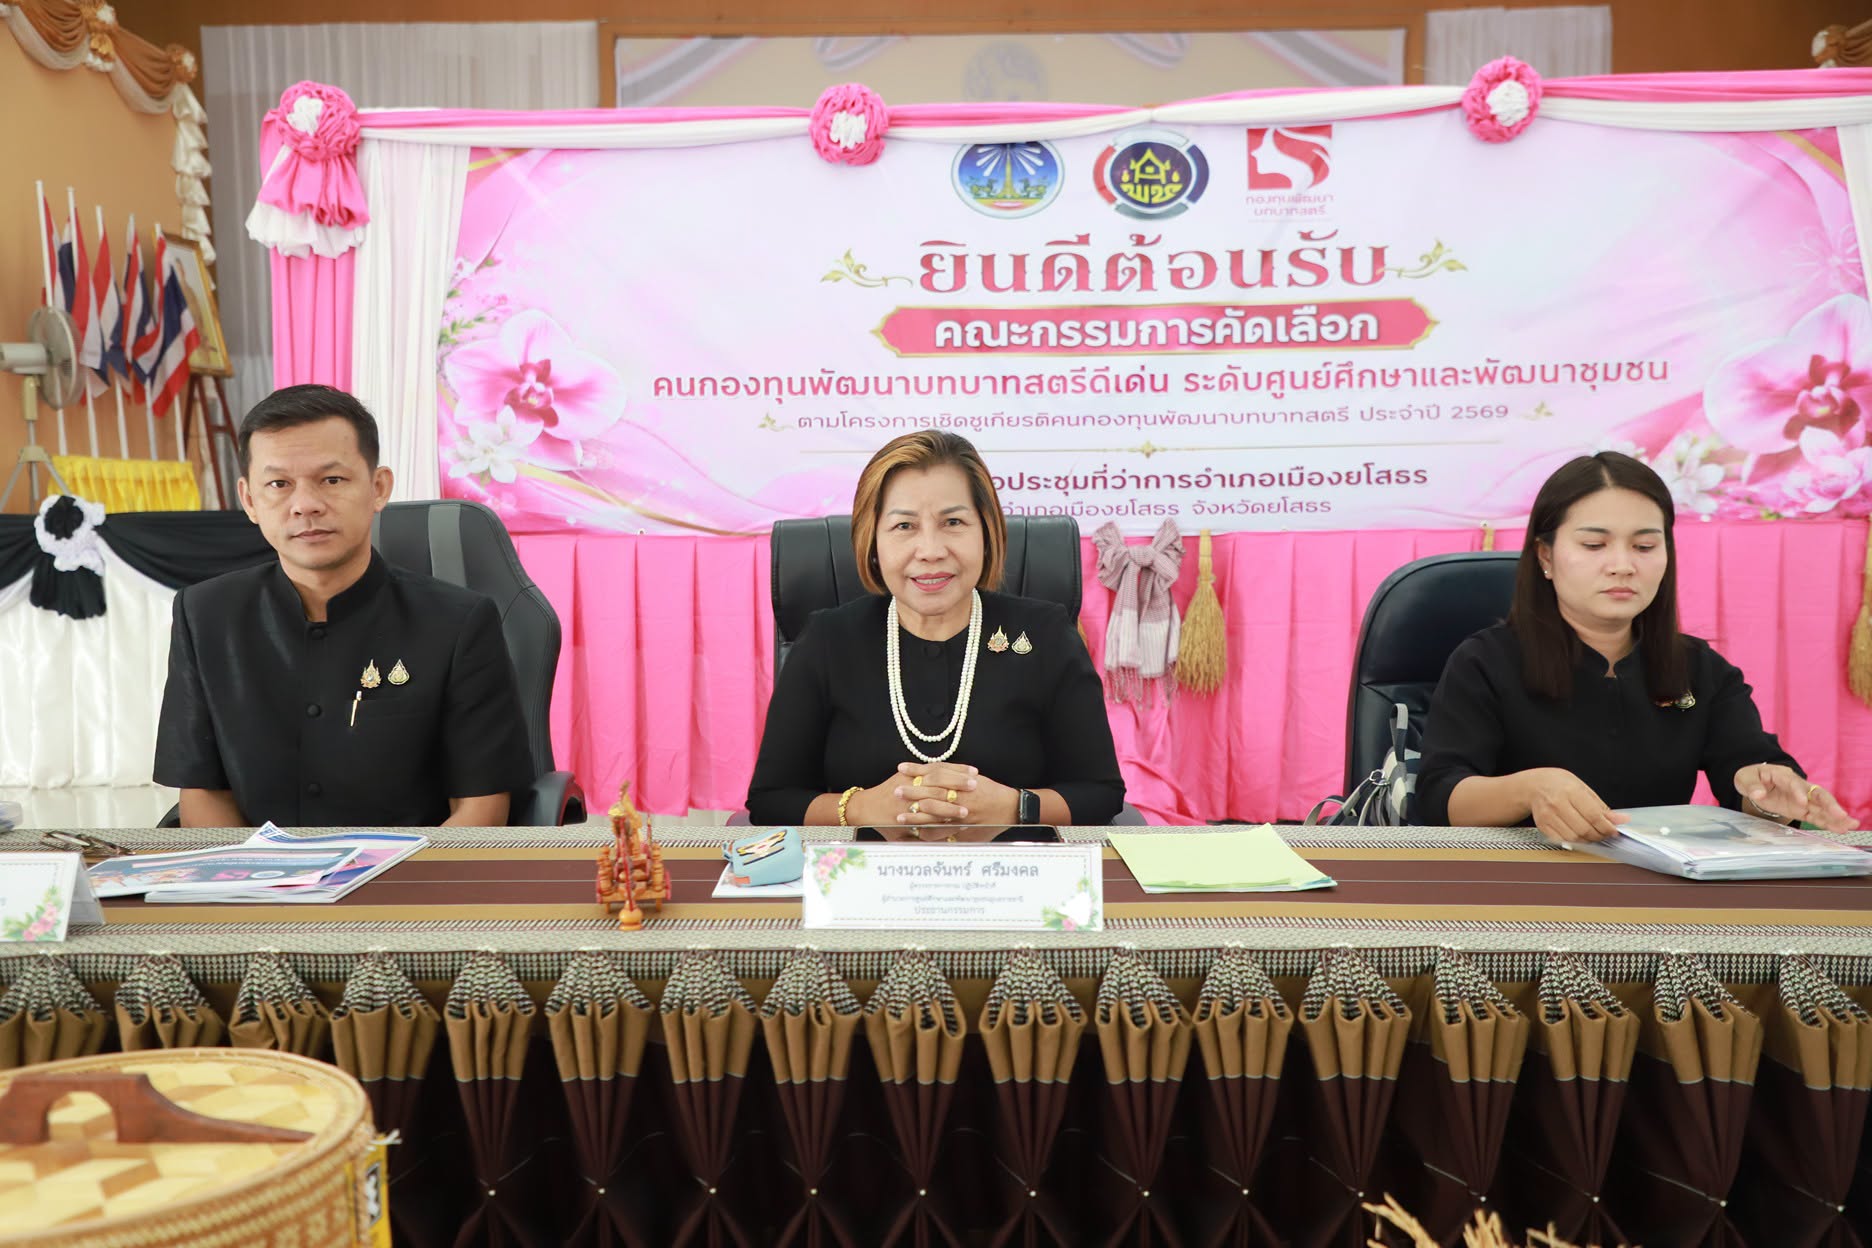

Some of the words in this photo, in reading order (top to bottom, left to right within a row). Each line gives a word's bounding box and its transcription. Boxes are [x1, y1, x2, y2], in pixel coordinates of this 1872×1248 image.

[919, 230, 1388, 292] ยินดีต้อนรับ
[935, 305, 1379, 348] คณะกรรมการคัดเลือก
[653, 366, 1169, 404] คนกองทุนพัฒนาบทบาทสตรีดีเด่น
[1183, 358, 1668, 399] ระดับศูนย์ศึกษาและพัฒนาชุมชน
[798, 407, 1350, 430] ตามโครงการเชิดชูเกียรติคนกองทุนพัฒนาบทบาทสตรี
[1359, 403, 1441, 423] ประจำปี
[1450, 405, 1509, 420] 2569
[1192, 496, 1332, 515] จังหวัดยโสธร
[877, 861, 973, 877] นางนวลจันทร์
[981, 861, 1040, 877] ศรีมงคล
